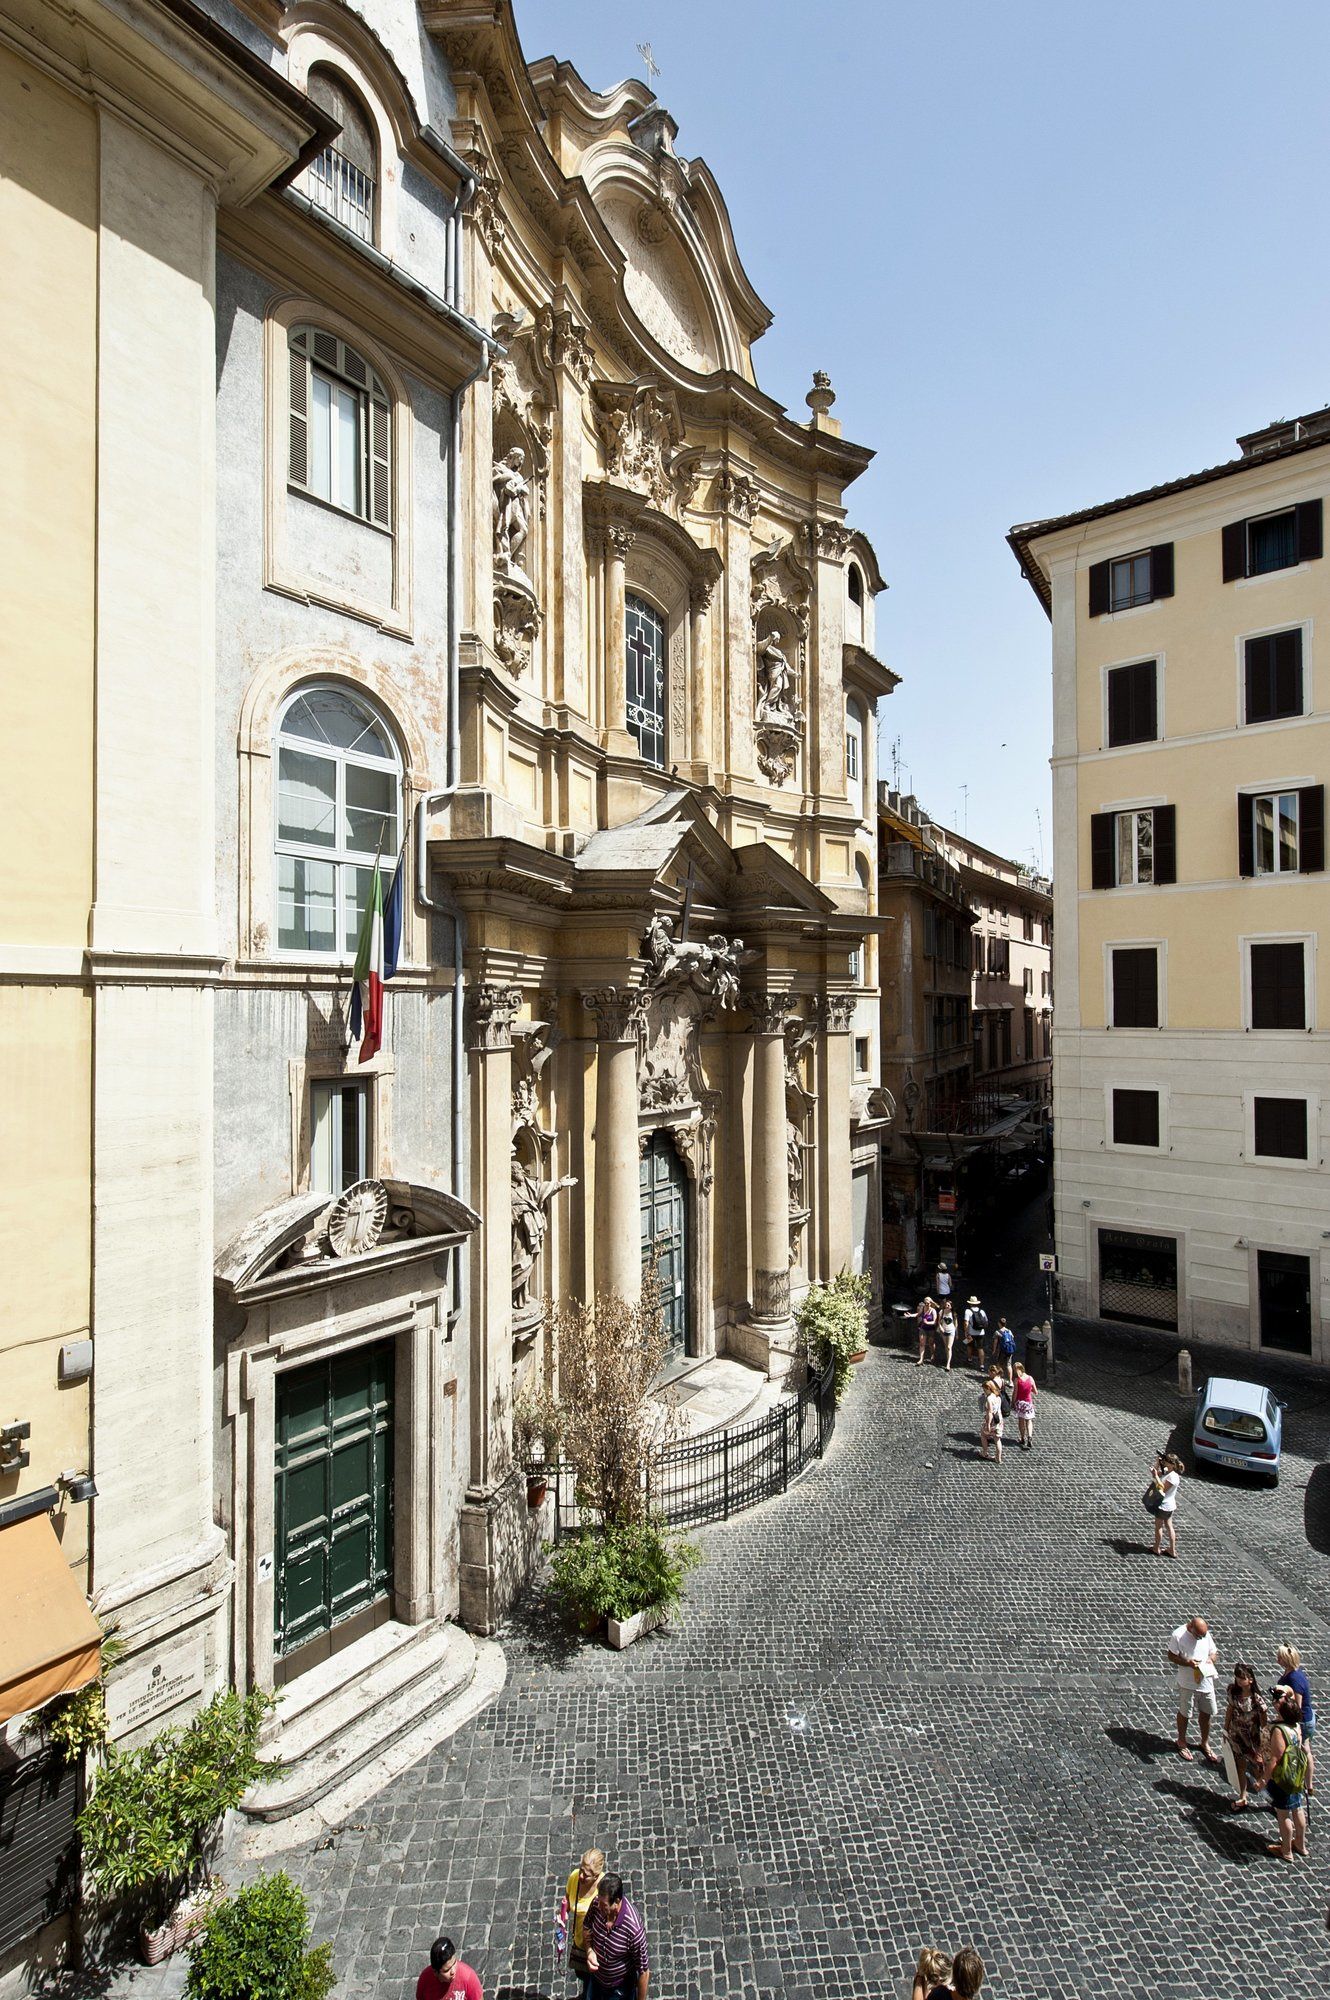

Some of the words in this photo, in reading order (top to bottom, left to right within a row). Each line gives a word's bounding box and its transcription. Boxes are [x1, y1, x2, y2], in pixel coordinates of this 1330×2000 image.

[116, 1712, 126, 1720] PER
[128, 1706, 136, 1714] LE
[139, 1691, 164, 1707] INDUSTRIE
[167, 1674, 194, 1692] ARTISTICHE
[130, 1691, 153, 1706] ISTITUTO
[157, 1675, 183, 1691] SUPERIORE
[147, 1676, 166, 1690] ISIA
[127, 1709, 149, 1724] DISEGNO
[153, 1689, 183, 1709] INDUSTRIALE
